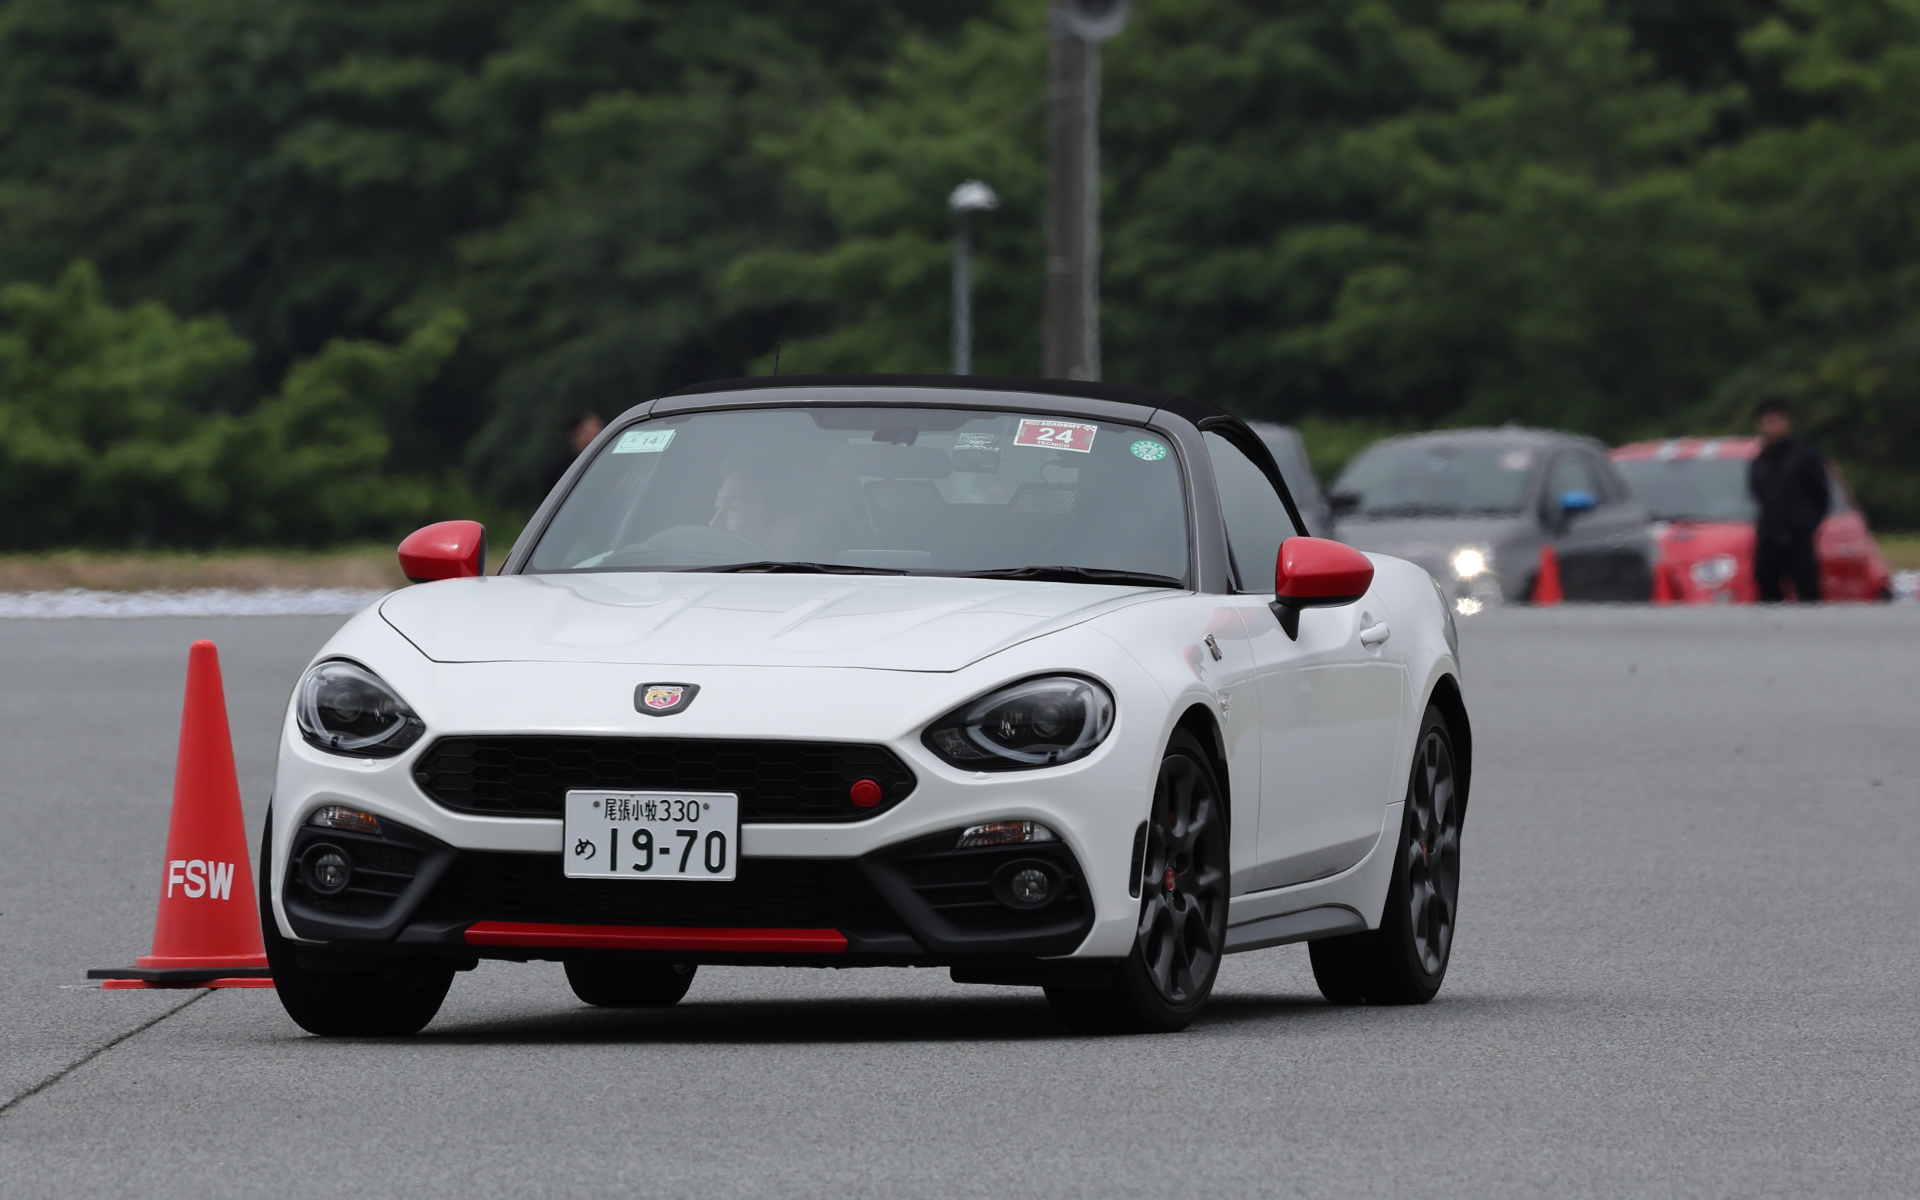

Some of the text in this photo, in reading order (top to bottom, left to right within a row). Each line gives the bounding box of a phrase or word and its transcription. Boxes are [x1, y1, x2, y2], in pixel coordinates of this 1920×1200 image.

[1040, 421, 1082, 429] ACADEMY
[642, 437, 659, 445] 14
[1036, 428, 1074, 443] 24
[574, 828, 727, 874] め 19-70
[167, 859, 235, 901] FSW
